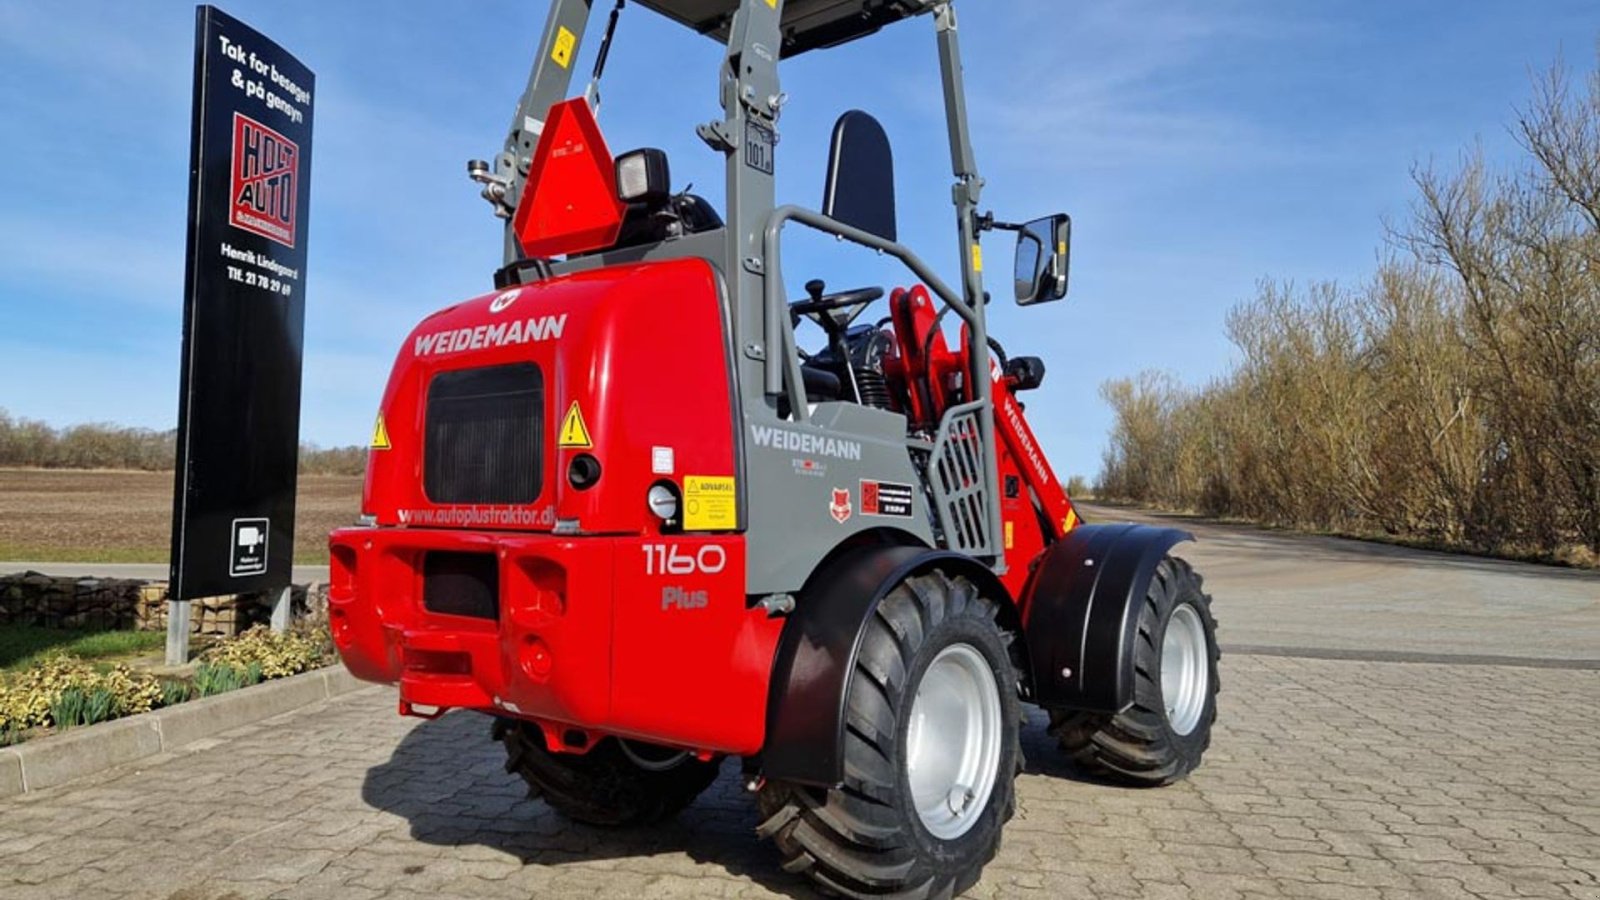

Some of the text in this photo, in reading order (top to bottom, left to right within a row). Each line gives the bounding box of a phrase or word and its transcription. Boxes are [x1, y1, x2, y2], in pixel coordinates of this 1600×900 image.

[219, 35, 246, 64] Tak
[249, 52, 270, 76] for
[231, 68, 303, 124] & på gensyn
[242, 124, 293, 179] HOLT
[238, 170, 292, 224] AUTO
[220, 242, 256, 266] Henrik
[245, 271, 257, 287] 21
[257, 275, 269, 290] 78
[413, 313, 568, 356] WEIDEMANN
[751, 425, 863, 461] WEIDEMANN
[641, 543, 726, 575] 1160
[661, 586, 709, 611] Plus
